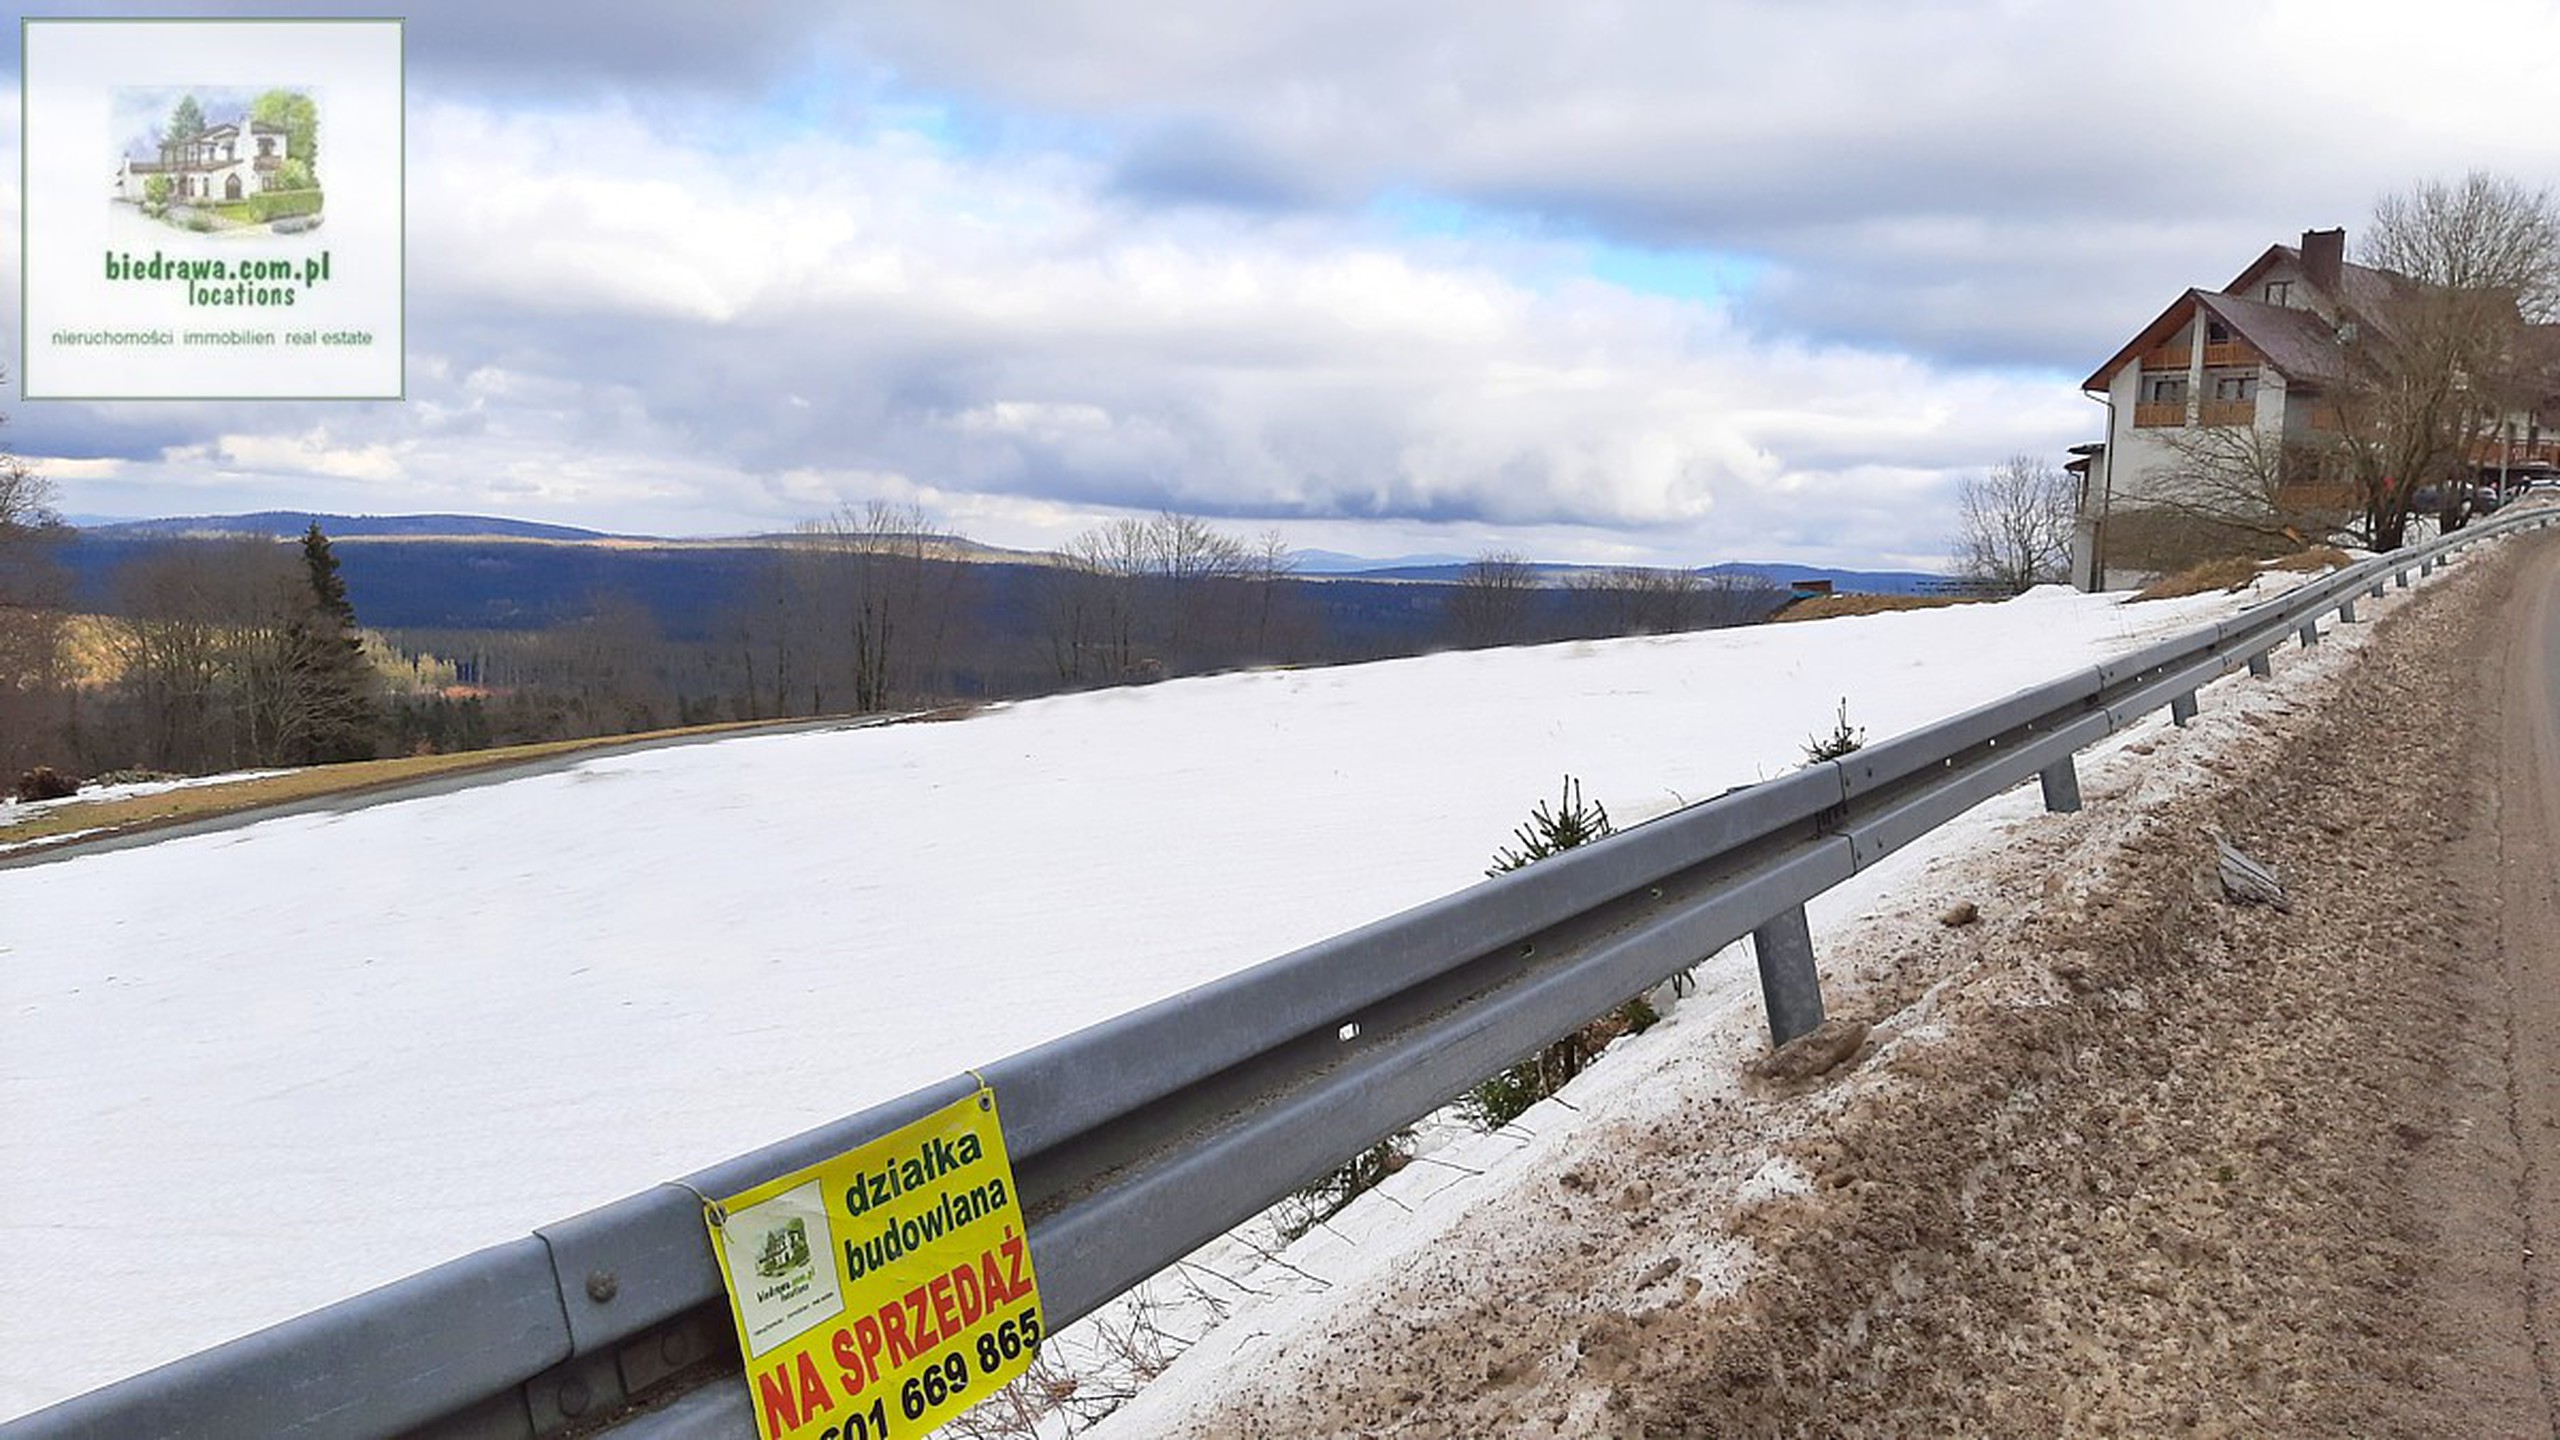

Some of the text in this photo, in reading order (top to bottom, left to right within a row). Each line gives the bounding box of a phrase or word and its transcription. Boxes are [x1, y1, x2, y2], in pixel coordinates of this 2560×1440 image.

[846, 1133, 983, 1217] działka
[844, 1188, 1008, 1281] budowlana
[758, 1225, 1033, 1440] NA SPRZEDAŻ
[901, 1352, 968, 1420] 669
[976, 1307, 1042, 1374] 865
